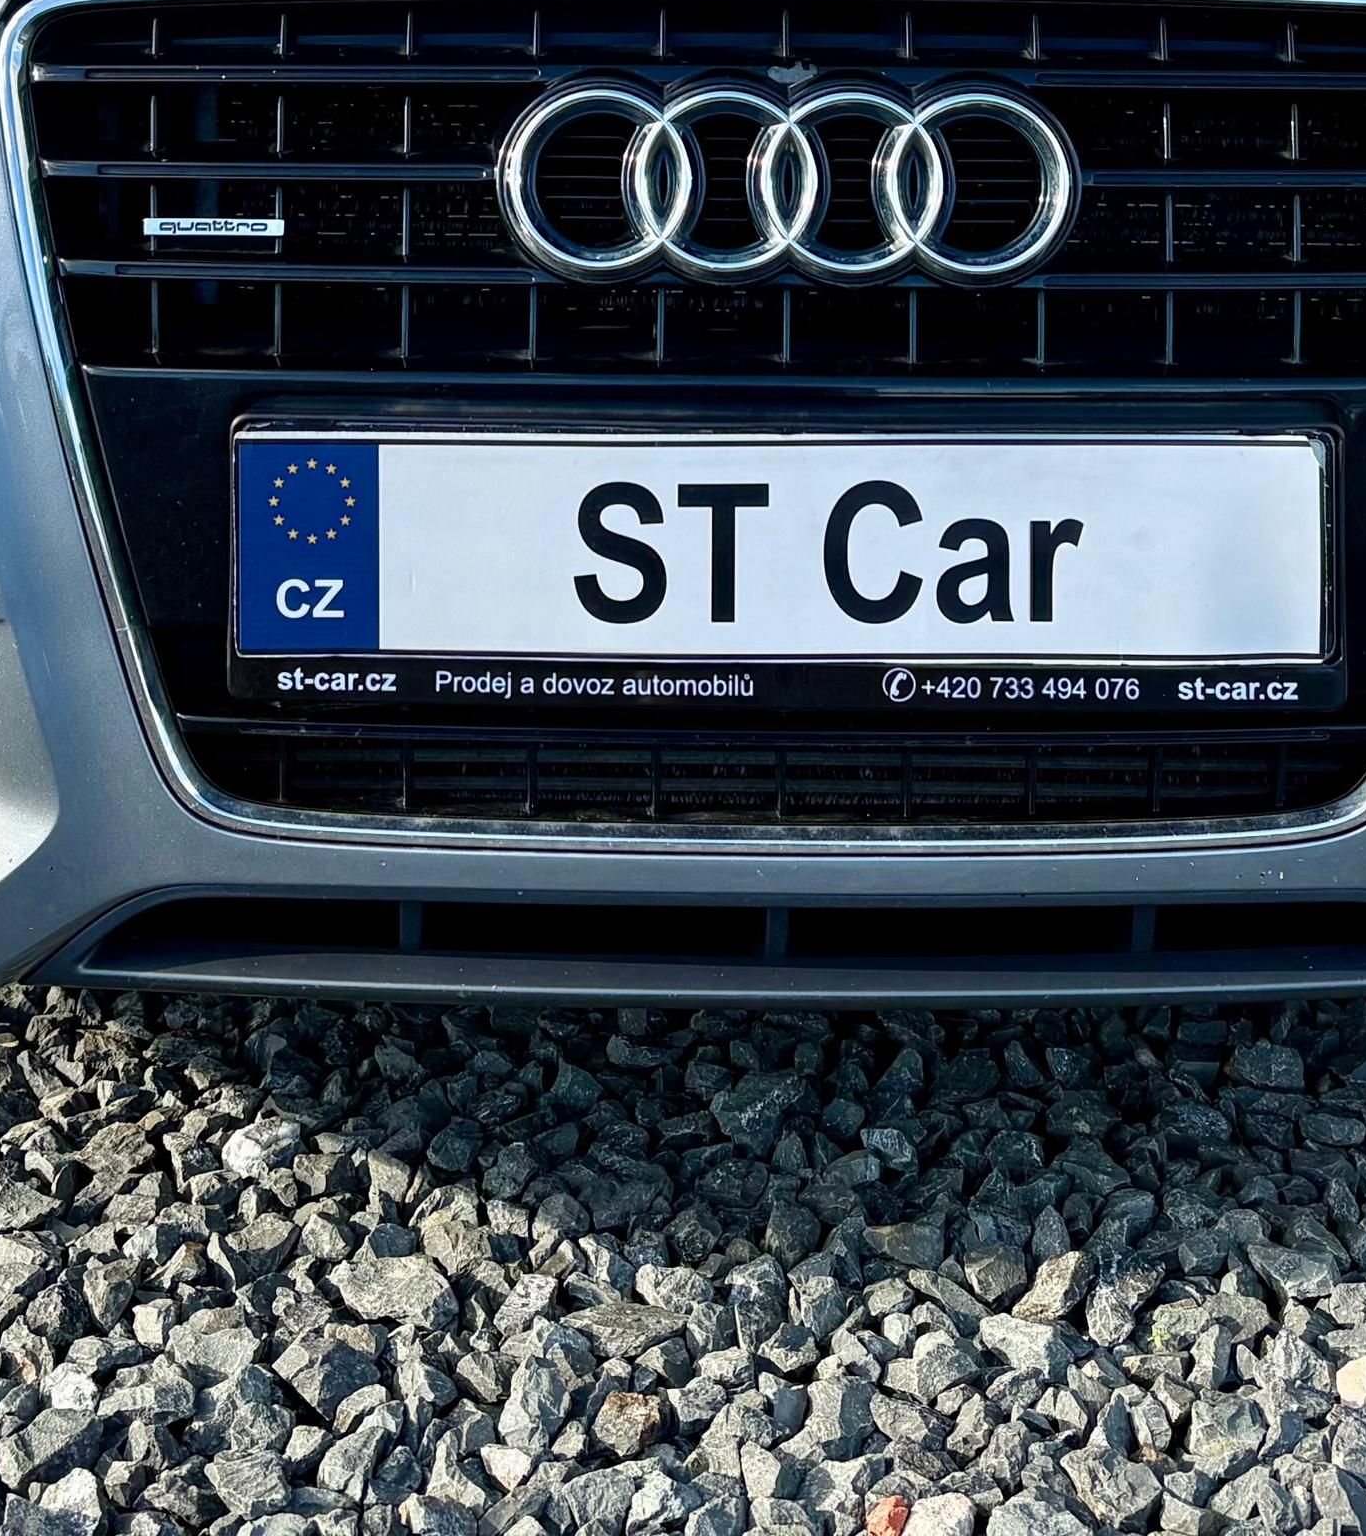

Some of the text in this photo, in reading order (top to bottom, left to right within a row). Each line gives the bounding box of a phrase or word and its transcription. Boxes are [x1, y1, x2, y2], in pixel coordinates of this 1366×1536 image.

[159, 220, 268, 234] quattro
[573, 479, 1084, 625] ST Car
[275, 578, 345, 619] CZ
[276, 667, 1299, 702] st-car.cz Prodej a dovoz automobilů +420 733 494 076 st-car.cz
